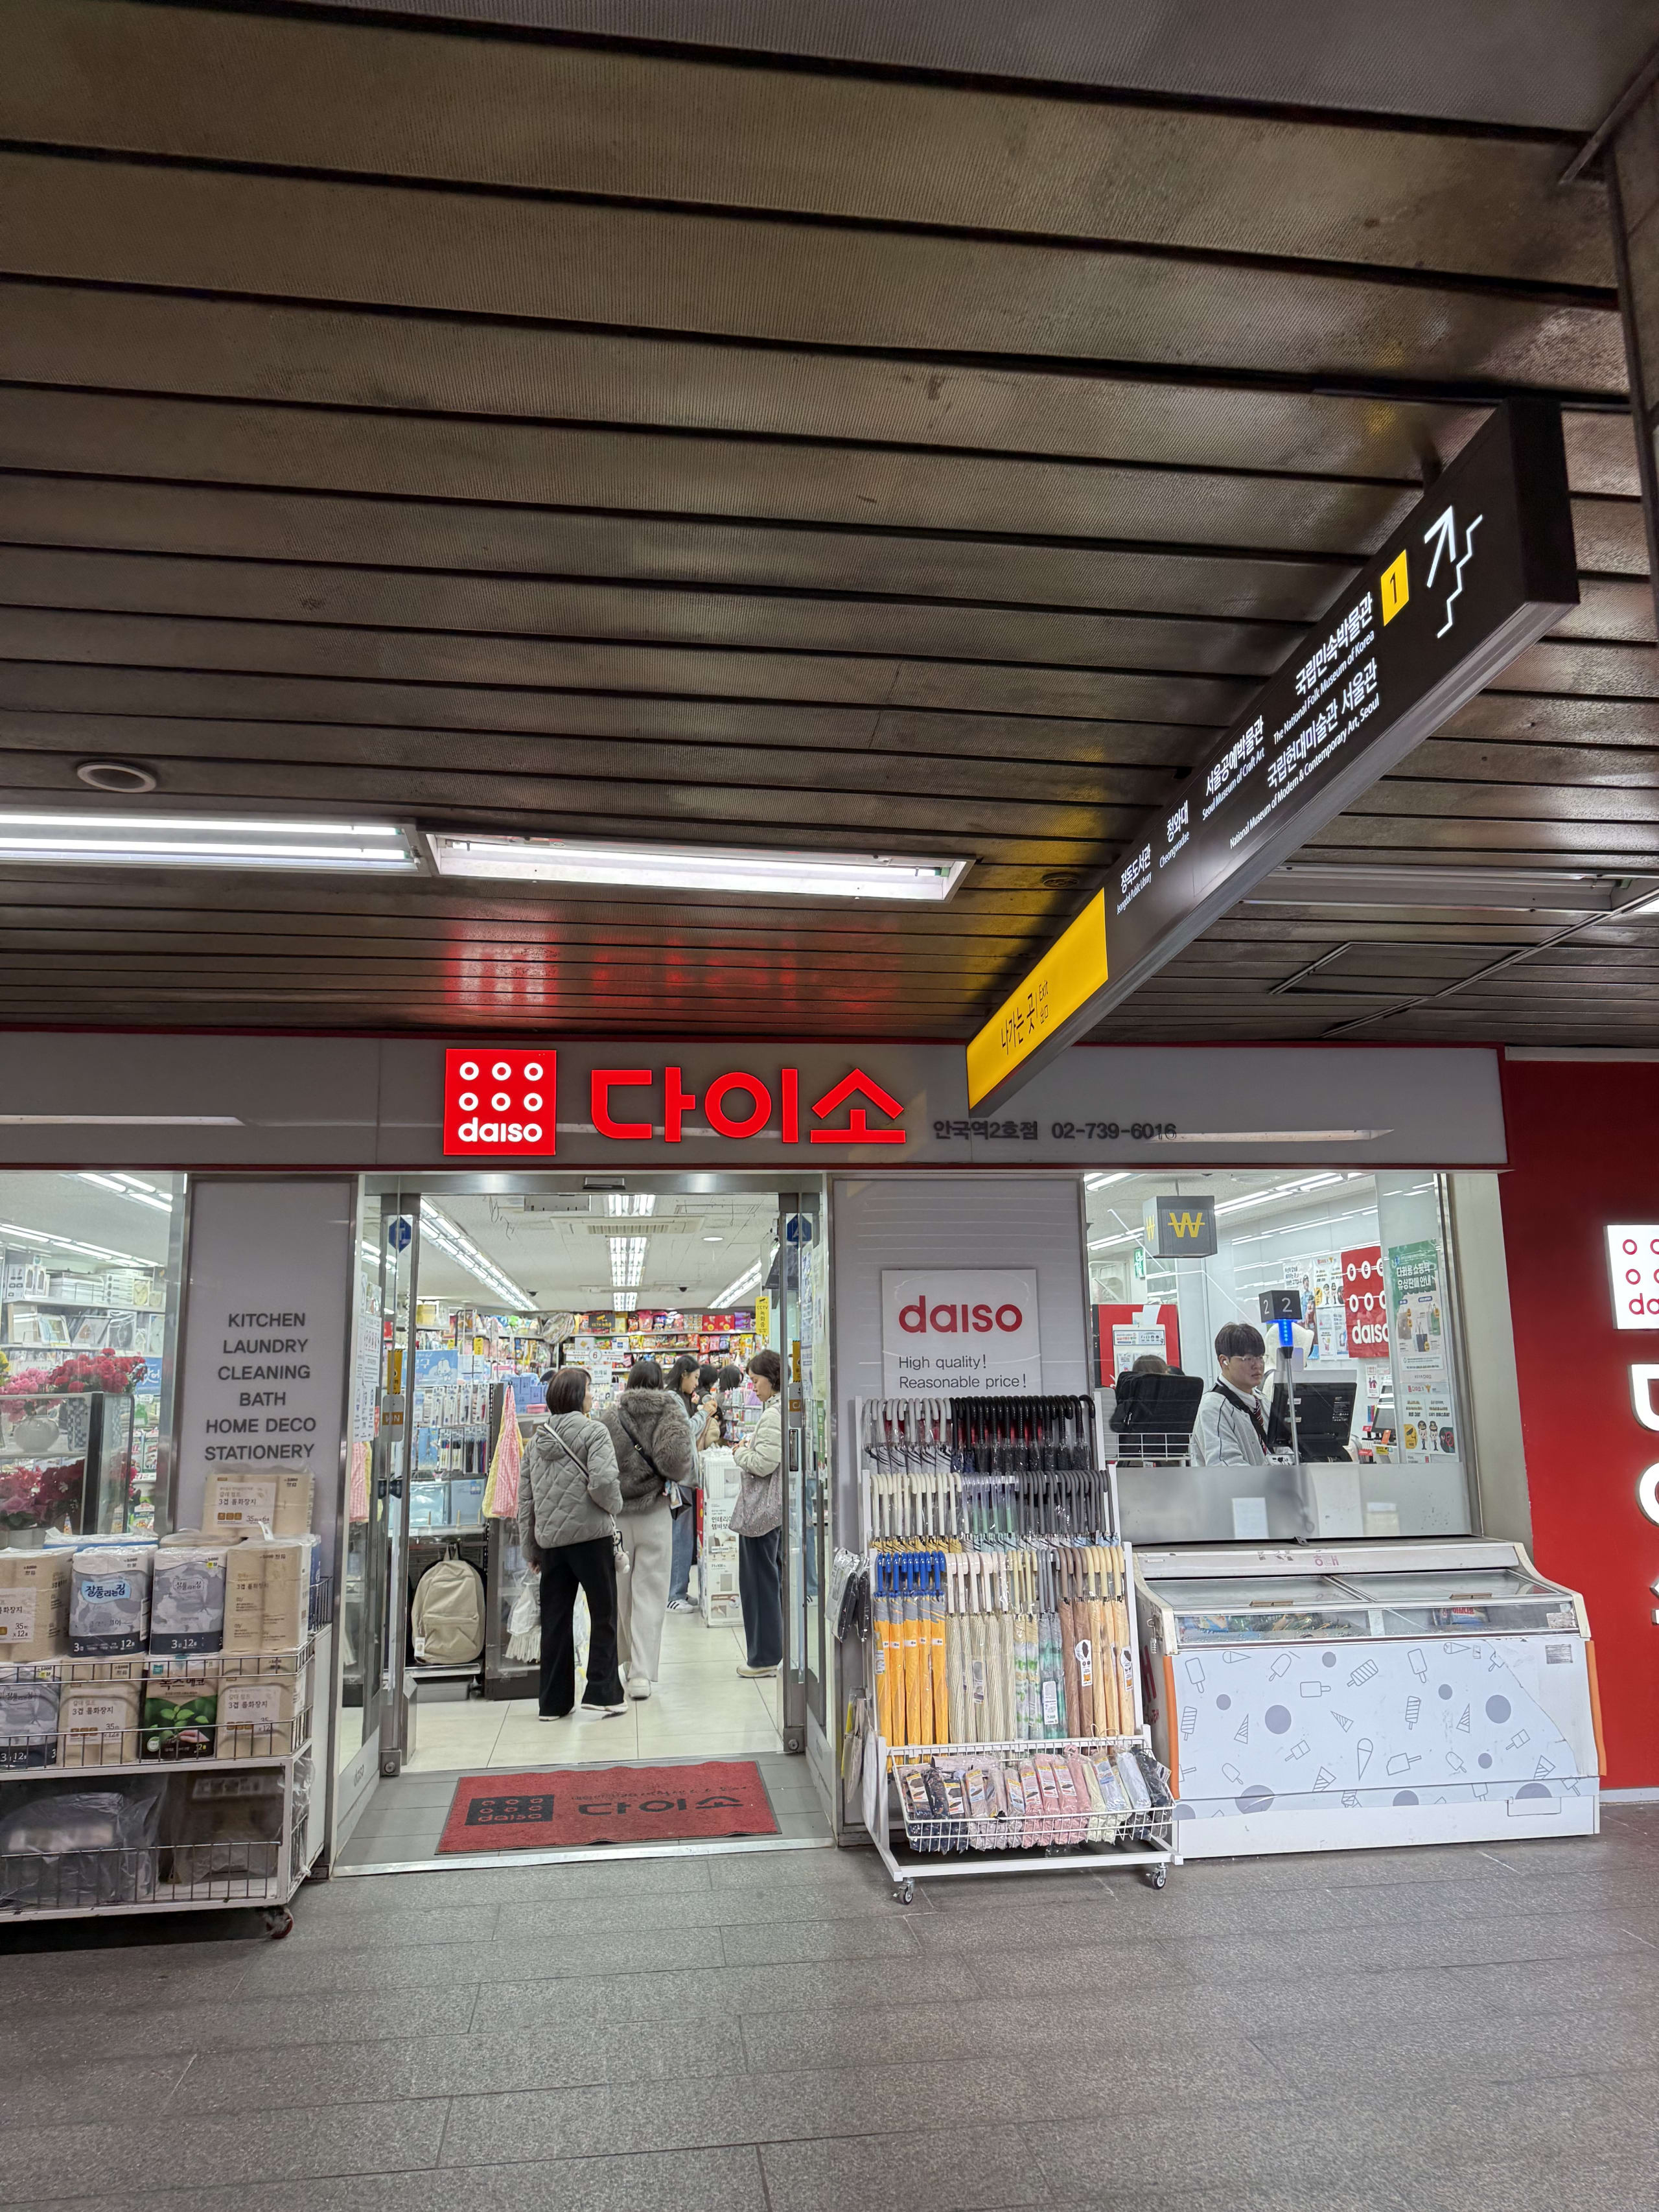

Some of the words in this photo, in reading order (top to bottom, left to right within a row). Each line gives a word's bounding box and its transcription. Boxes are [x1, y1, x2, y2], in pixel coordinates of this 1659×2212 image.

[1389, 572, 1397, 605] 1
[1295, 591, 1373, 695] 국립민속박물관
[1273, 729, 1284, 745] The
[1284, 700, 1307, 734] National
[1307, 688, 1320, 710] Folk
[1320, 660, 1347, 695] Museum
[1347, 646, 1354, 666] of
[1354, 630, 1375, 657] Korea
[1267, 698, 1338, 788] 국립현대미술관
[1341, 657, 1377, 714] 서울관
[1205, 714, 1264, 797] 서울공예박물관
[1229, 821, 1250, 850] National
[1249, 803, 1271, 830] Museum
[1271, 793, 1277, 809] of
[1277, 776, 1299, 804] Modern
[1299, 769, 1305, 782] &
[1304, 727, 1347, 776] Contemporary
[1347, 716, 1360, 735] Art,
[1360, 692, 1380, 723] Seoul
[1202, 797, 1216, 821] Seoul
[1215, 778, 1236, 806] Museum
[1236, 769, 1243, 784] of
[1242, 756, 1256, 777] Craft
[1255, 747, 1265, 765] Art
[1167, 799, 1189, 843] 청와대
[1159, 831, 1190, 868] Cheongwadae
[1120, 843, 1151, 894] 정독도서관
[1117, 892, 1130, 915] Jeongdok
[1130, 882, 1141, 901] Public
[1141, 872, 1152, 891] Library
[1039, 979, 1049, 1002] Exit
[1001, 1007, 1024, 1055] 나가는
[1026, 992, 1035, 1035] 곳
[1039, 1005, 1049, 1024] 出口
[591, 1066, 906, 1143] 다이소
[458, 1117, 542, 1143] daiso
[933, 1121, 1038, 1141] 안국역2호점
[1051, 1122, 1177, 1141] 02-739-6016
[1397, 1264, 1413, 1277] 다회용
[1419, 1274, 1432, 1287] 안내
[899, 1295, 1023, 1333] daiso
[1264, 1299, 1270, 1315] 2
[1282, 1297, 1293, 1312] 2
[228, 1312, 305, 1327] KITCHEN
[223, 1339, 308, 1354] LAUNDRY
[899, 1356, 930, 1370] High
[935, 1354, 986, 1370] quality!
[218, 1365, 310, 1380] CLEANING
[899, 1375, 980, 1389] Reasonable
[986, 1373, 1027, 1390] price!
[239, 1392, 286, 1406] BATH
[206, 1419, 259, 1434] HOME
[265, 1417, 316, 1432] DECO
[204, 1444, 314, 1461] STATIONERY
[85, 1583, 126, 1599] 잘풀리는집
[72, 1707, 84, 1716] 3겹
[86, 1706, 113, 1715] 롤화장지
[578, 1796, 745, 1816] 다이소
